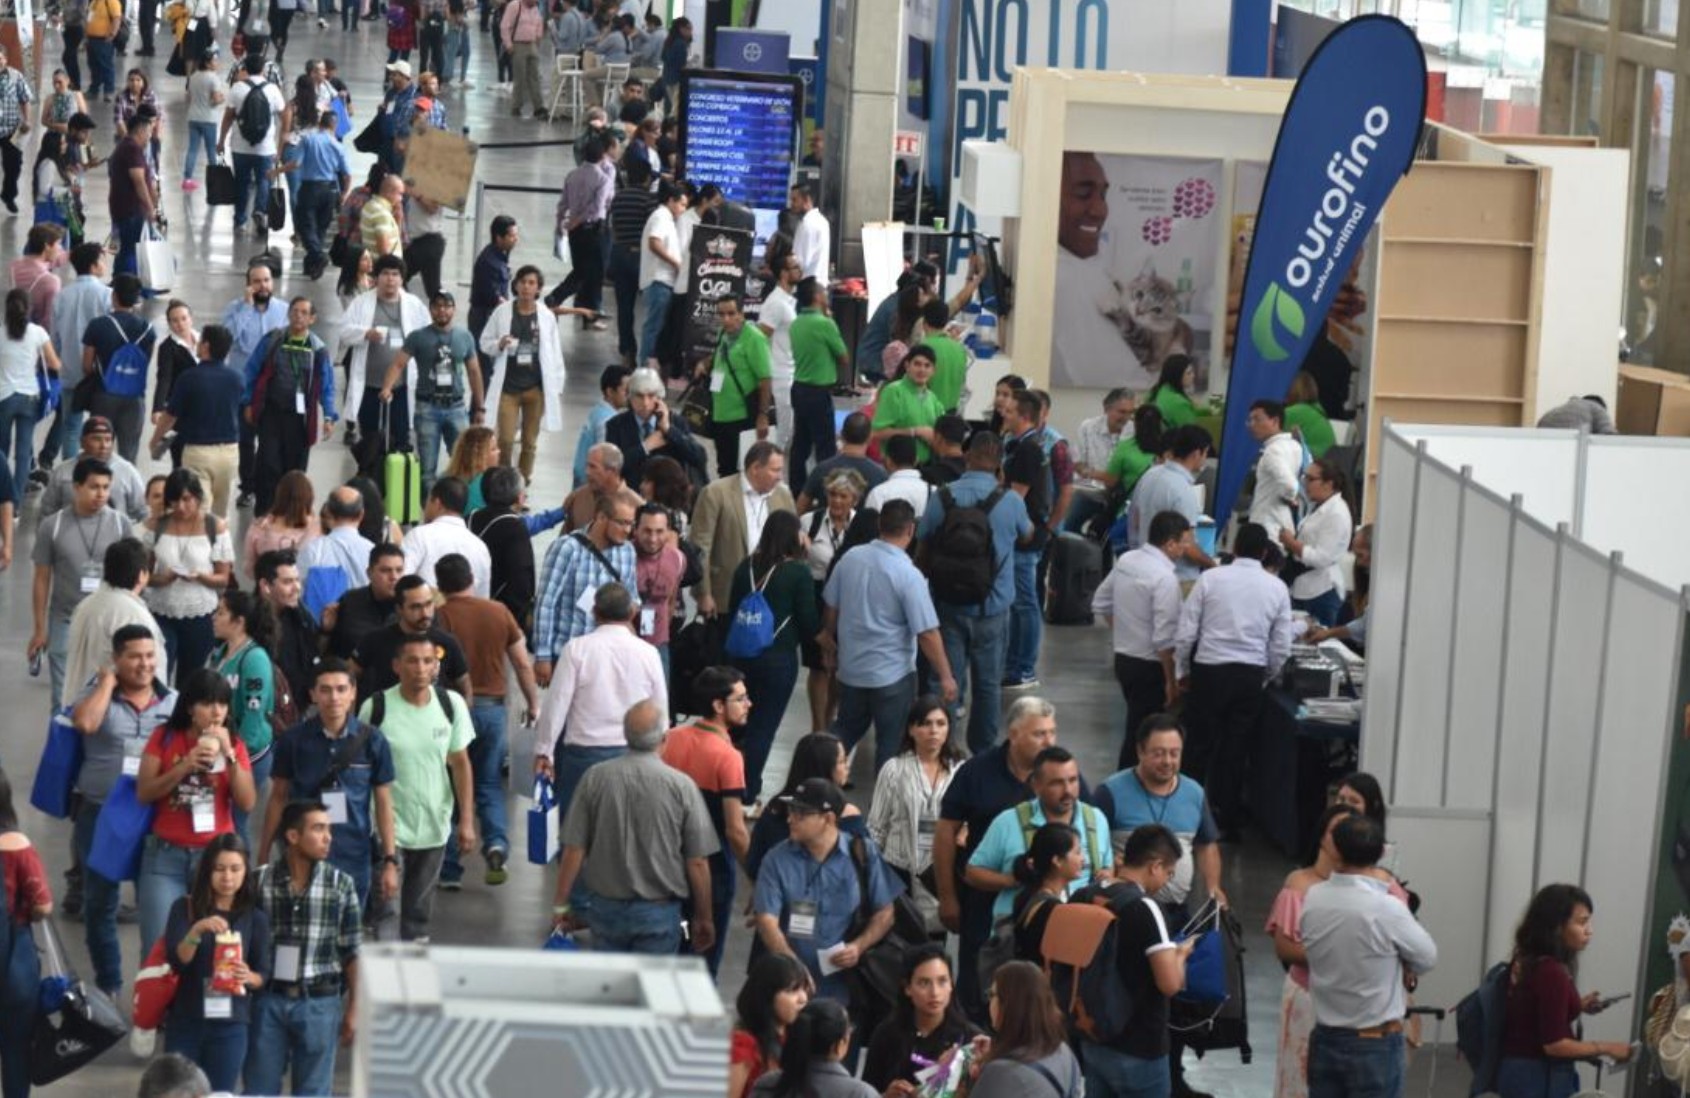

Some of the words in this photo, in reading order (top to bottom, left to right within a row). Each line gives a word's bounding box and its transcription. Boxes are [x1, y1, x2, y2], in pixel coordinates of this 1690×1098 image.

[958, 0, 1029, 82] NO
[1286, 105, 1390, 288] ourofino
[1333, 202, 1367, 258] animal
